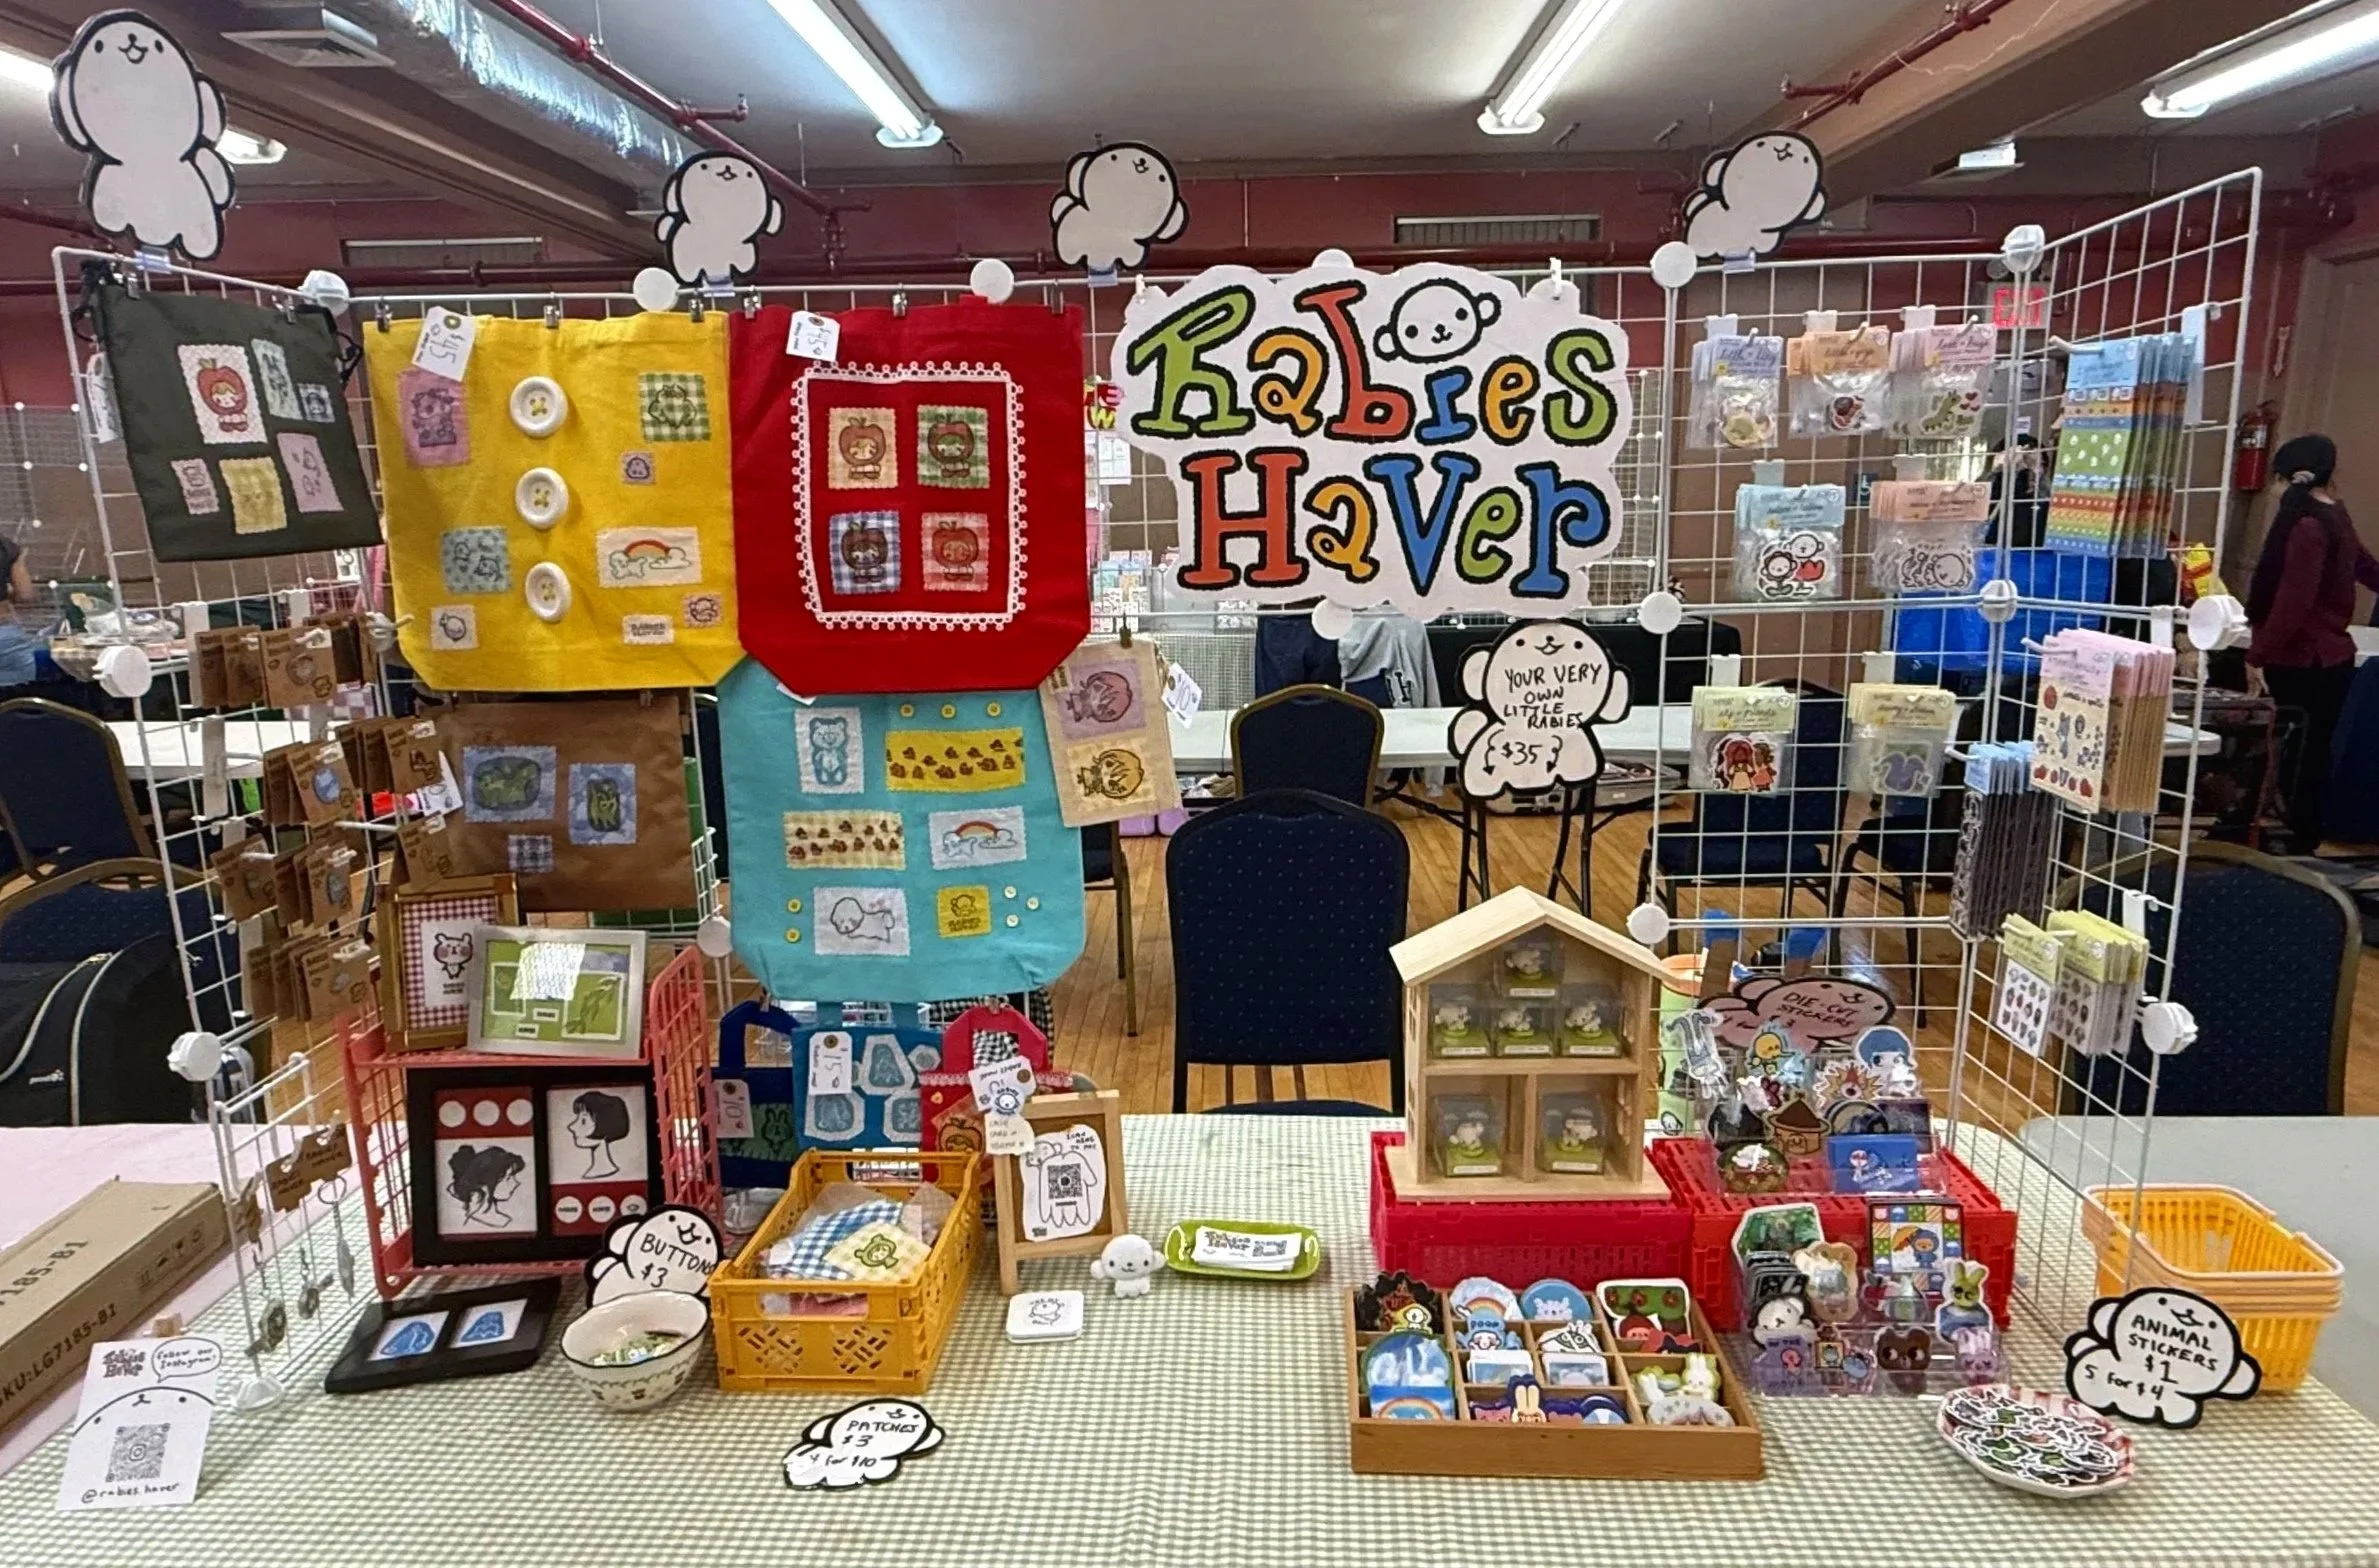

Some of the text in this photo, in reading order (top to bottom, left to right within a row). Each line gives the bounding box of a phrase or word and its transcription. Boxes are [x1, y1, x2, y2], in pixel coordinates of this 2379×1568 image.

[1126, 279, 1619, 446] Rabies
[1177, 447, 1611, 596] Haver
[1505, 663, 1602, 693] YOUR VERY
[1524, 686, 1564, 704] OWN
[1504, 703, 1565, 718] LITTLE
[1527, 712, 1584, 729] RABIES
[1501, 741, 1543, 765] $35
[1777, 1004, 1854, 1028] STICKERS
[0, 1241, 89, 1305] 185-B1
[641, 1262, 668, 1288] $3
[2131, 1314, 2212, 1351] ANIMAL
[2128, 1333, 2219, 1372] STICKERS
[2145, 1354, 2179, 1384] $1
[2085, 1364, 2098, 1379] 5
[2137, 1382, 2164, 1401] $4
[847, 1420, 919, 1434] PATCHES
[842, 1434, 874, 1448] $3
[810, 1453, 877, 1468] 4 for $10
